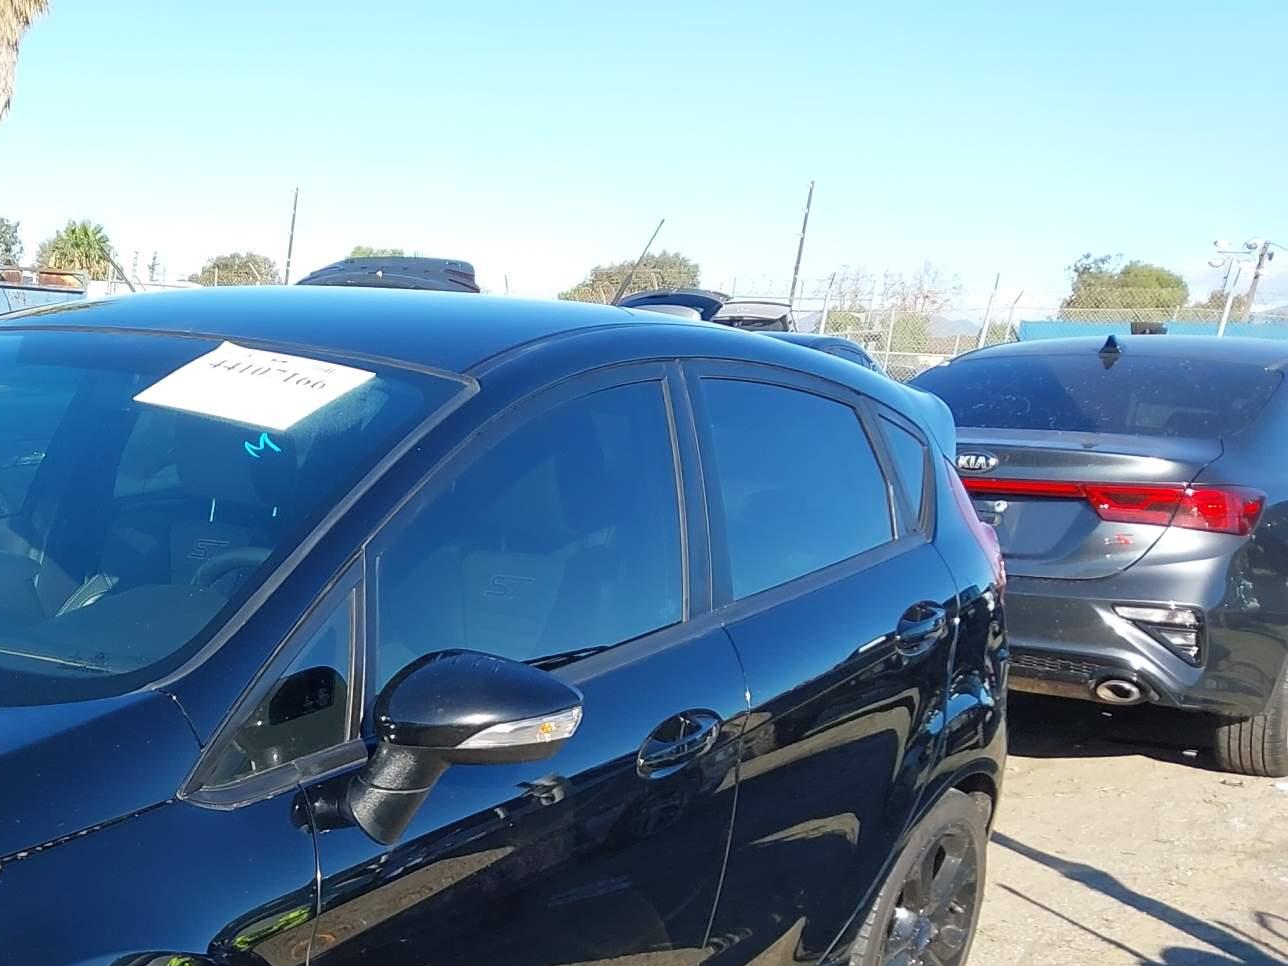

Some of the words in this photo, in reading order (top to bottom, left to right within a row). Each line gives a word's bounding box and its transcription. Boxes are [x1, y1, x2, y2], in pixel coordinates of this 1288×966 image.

[209, 360, 327, 389] 44107166
[244, 432, 282, 458] M
[958, 455, 988, 469] KIA
